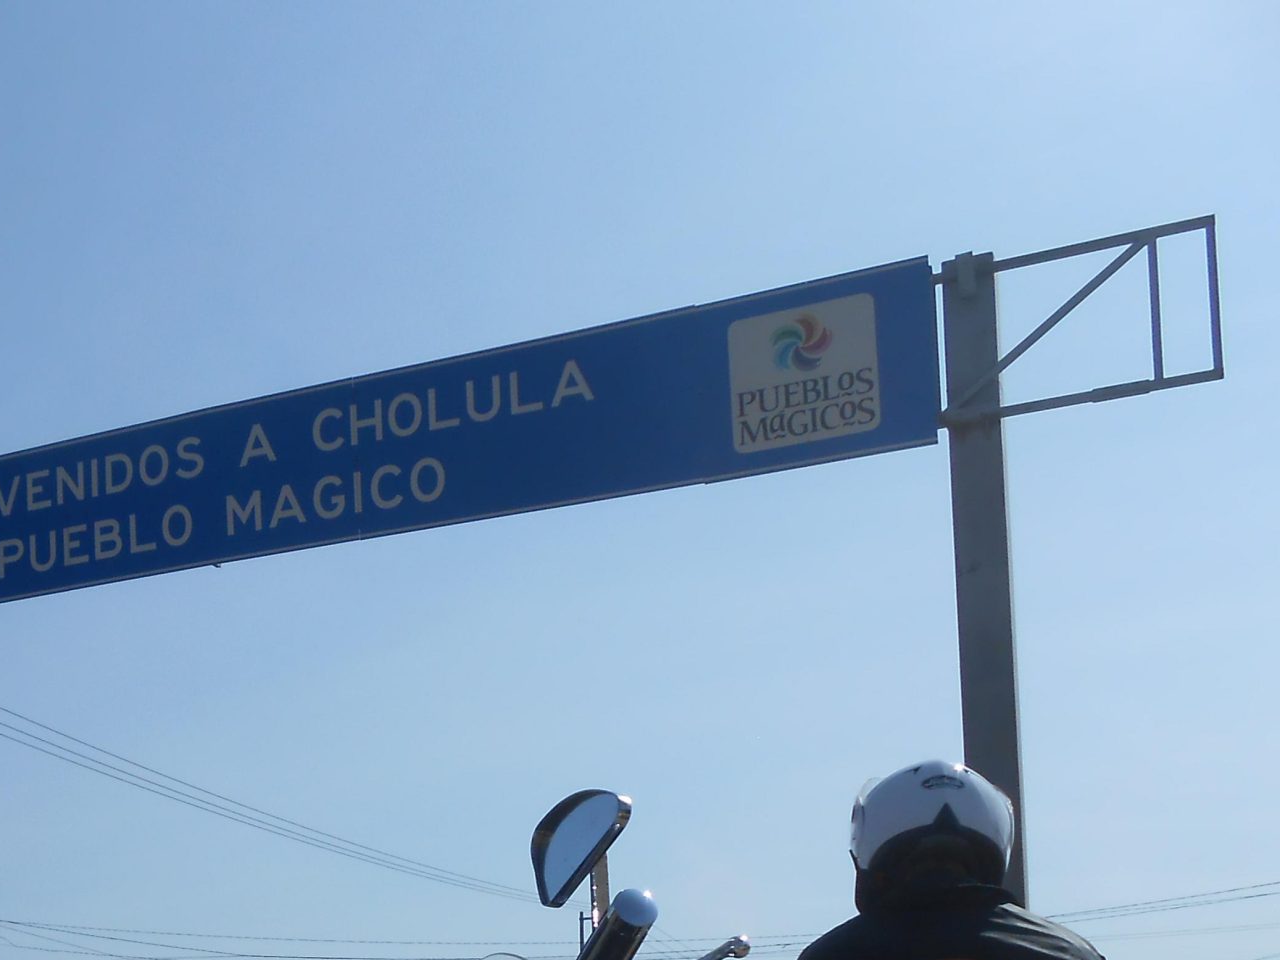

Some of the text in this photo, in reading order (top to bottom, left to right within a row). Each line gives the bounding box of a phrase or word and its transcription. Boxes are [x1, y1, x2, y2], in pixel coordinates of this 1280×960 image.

[239, 423, 277, 467] A
[311, 359, 595, 453] CHOLULA
[225, 457, 447, 537] MAGICO
